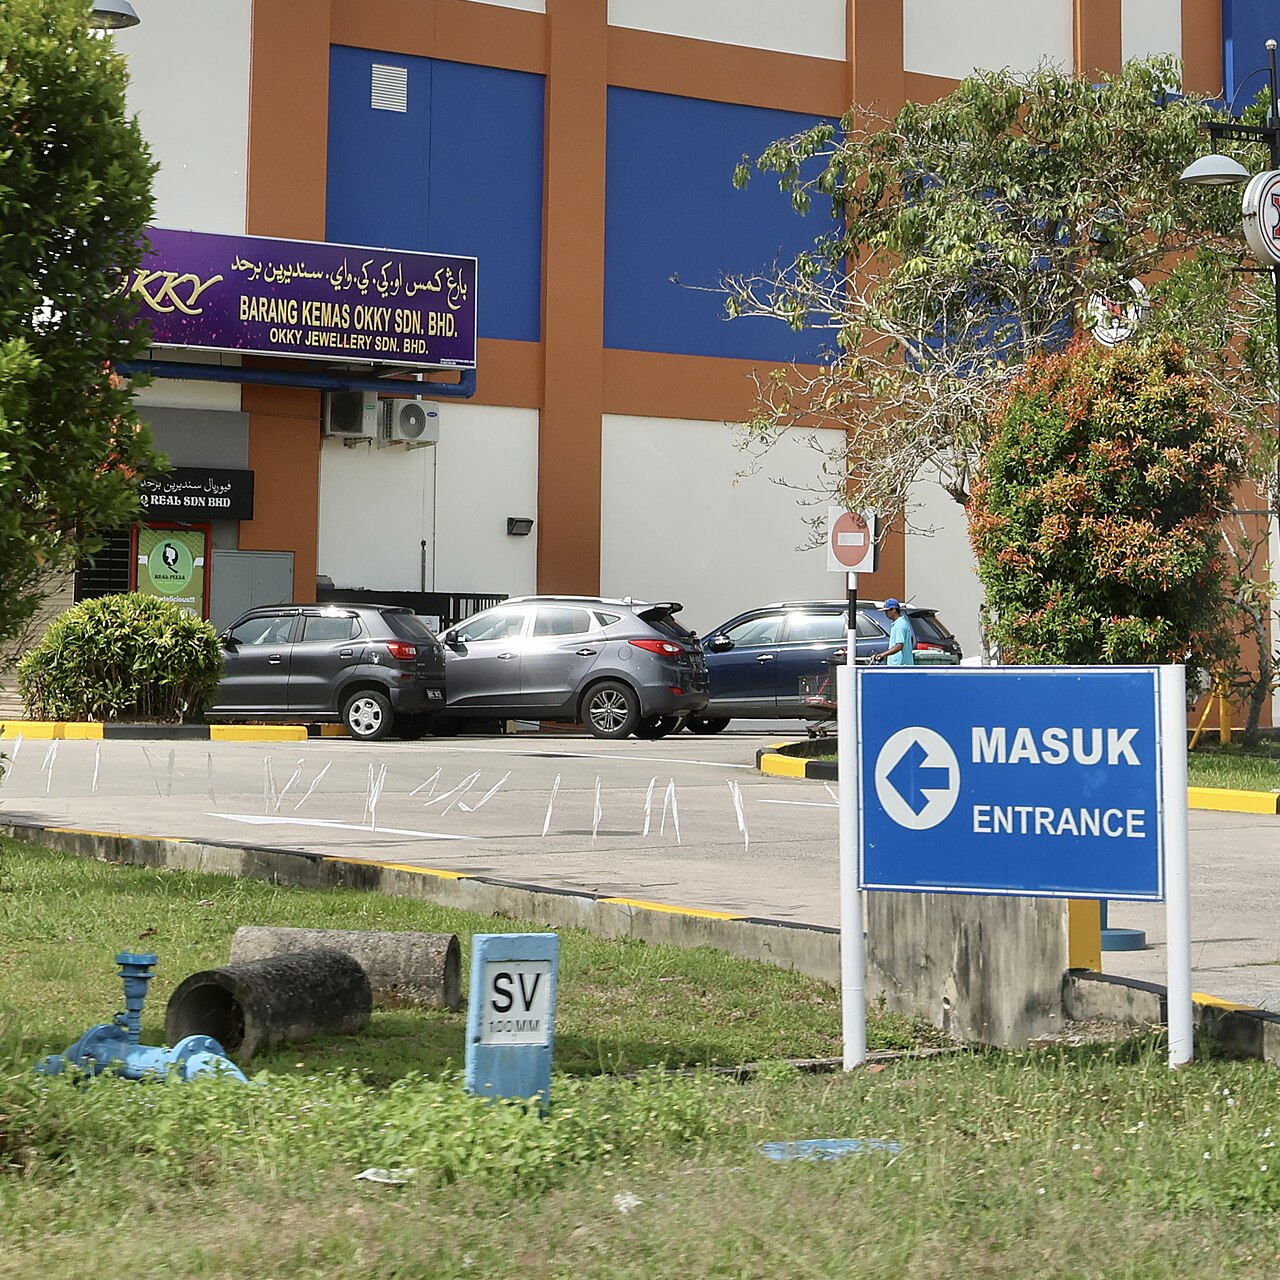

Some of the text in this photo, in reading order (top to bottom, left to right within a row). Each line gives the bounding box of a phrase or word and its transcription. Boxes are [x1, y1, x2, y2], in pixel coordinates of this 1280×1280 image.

[231, 255, 262, 280] برحد
[240, 295, 458, 338] BARANG KEMAS OKKY SDN. BHD.
[270, 328, 429, 355] OKKY JEWELLERY SDN. BHD.
[140, 480, 161, 491] برحد
[140, 494, 231, 508] Q REAL SDN BHD
[971, 727, 1141, 766] MASUK
[973, 805, 1147, 838] ENTRANCE
[492, 972, 541, 1013] SV
